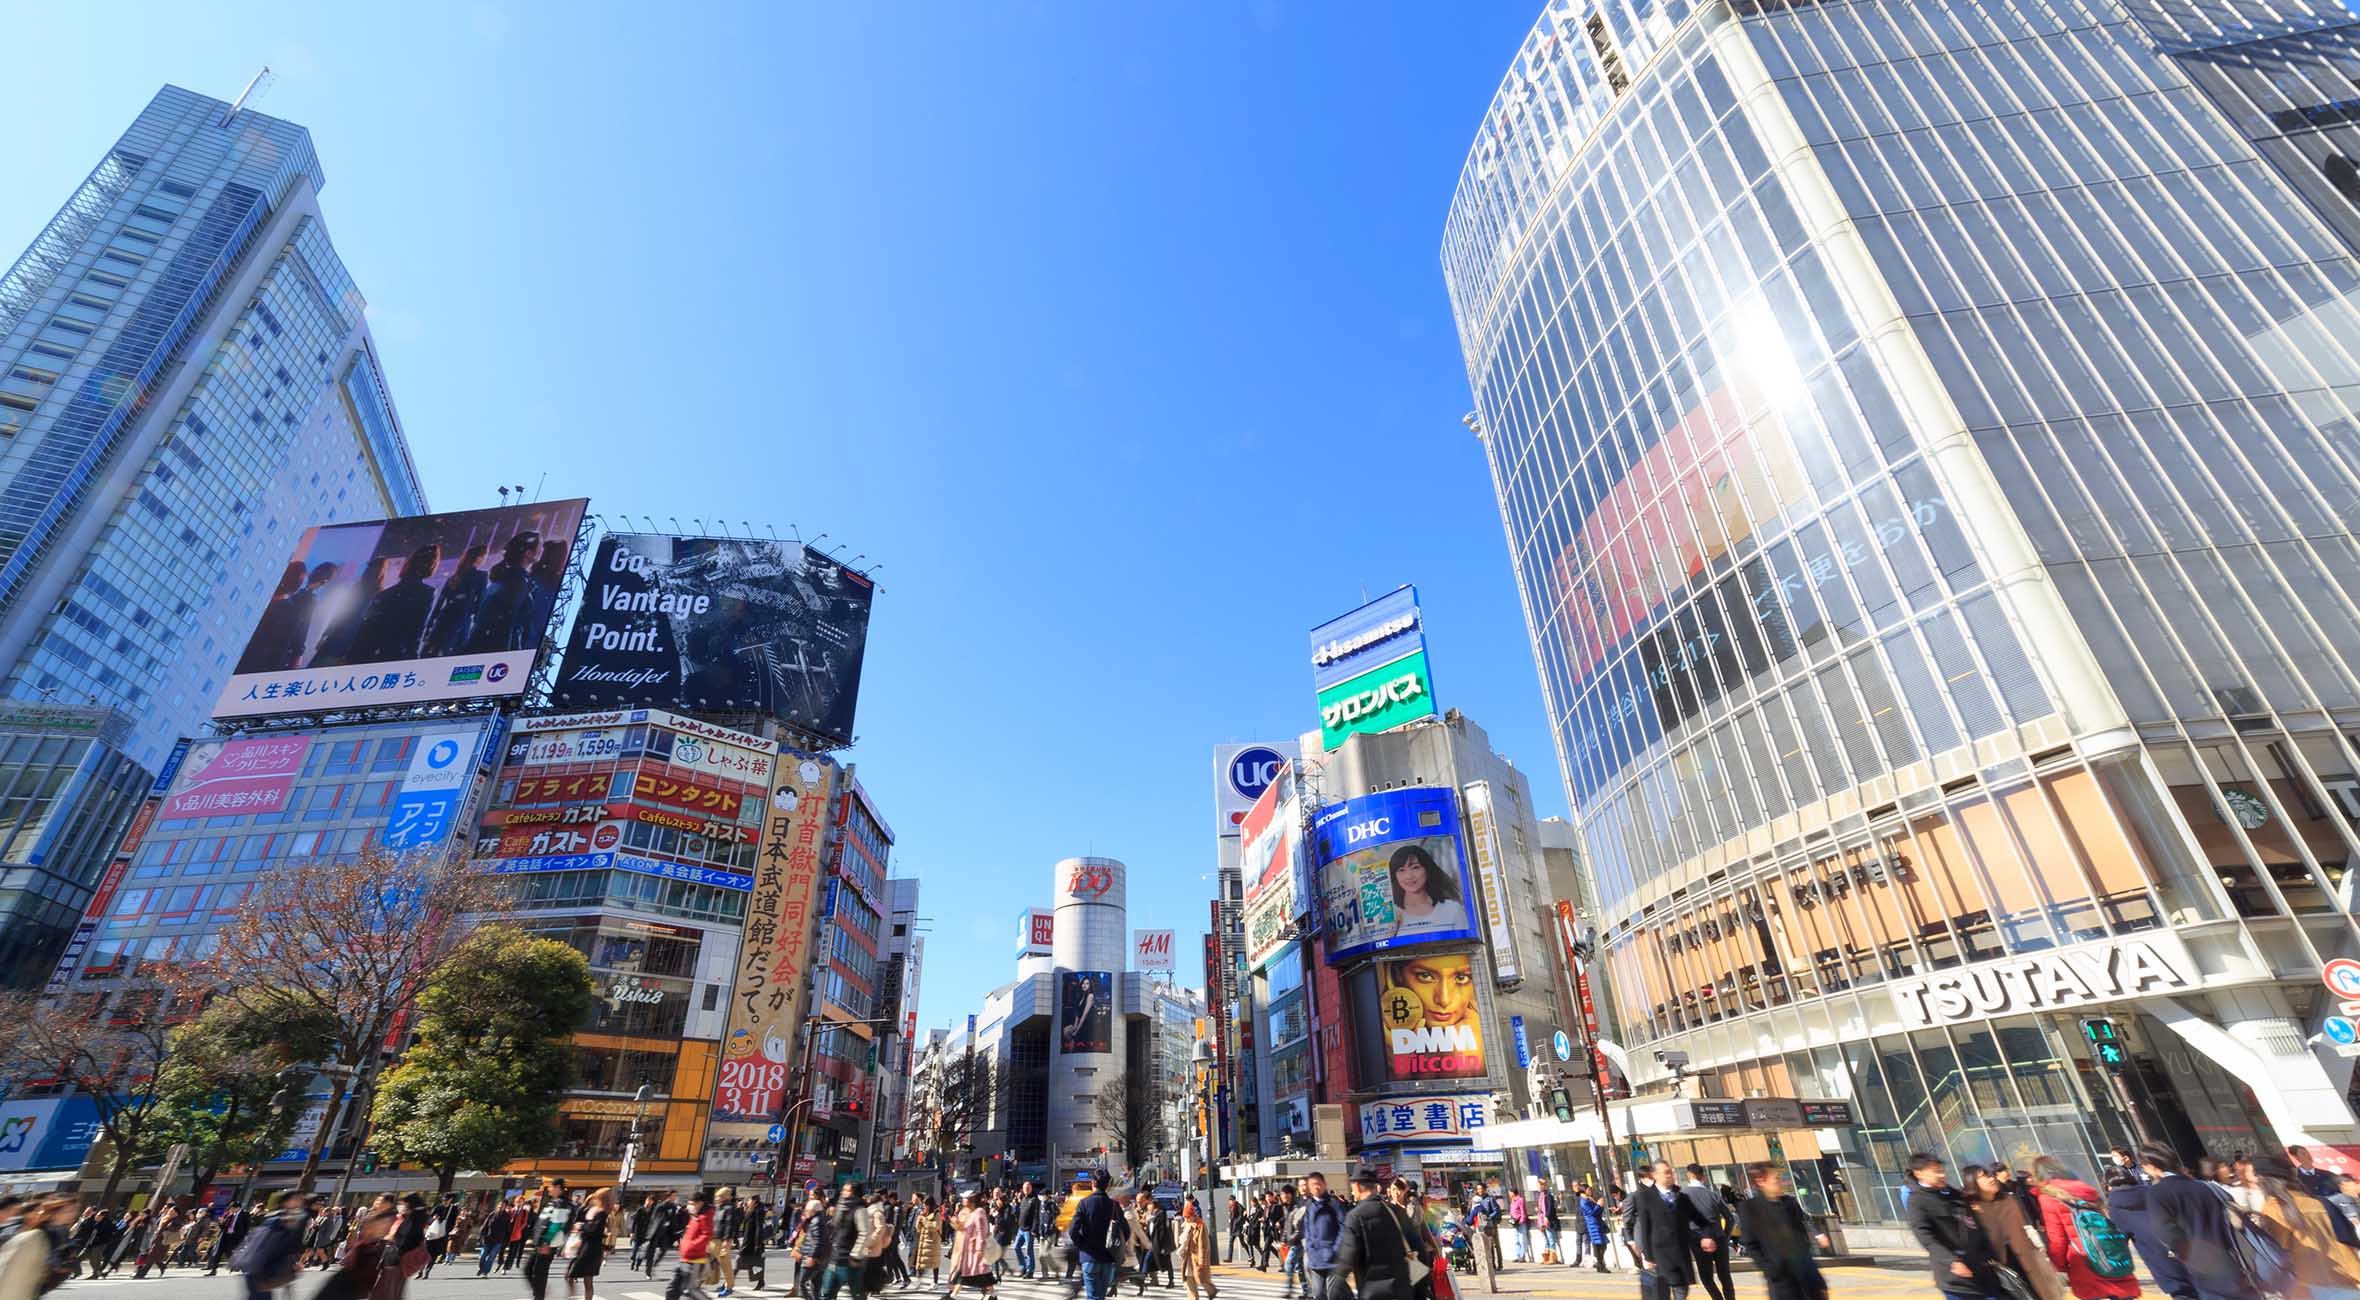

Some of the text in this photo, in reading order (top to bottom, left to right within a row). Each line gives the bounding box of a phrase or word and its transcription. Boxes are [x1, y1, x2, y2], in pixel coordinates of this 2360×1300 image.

[609, 547, 646, 572] Go
[601, 585, 709, 619] Vantage
[585, 624, 664, 652] Point.
[489, 667, 507, 678] UC
[569, 665, 671, 689] HondaJet
[242, 671, 426, 701] 人生楽しい人の勝ち。
[1322, 672, 1422, 728] サロンパス
[510, 744, 529, 756] 9F
[707, 748, 768, 775] しゃぶ葉
[635, 776, 737, 811] コンタクト
[562, 806, 608, 823] ガスト
[529, 832, 587, 854] ガスト
[701, 821, 748, 842] ガスト
[1347, 817, 1390, 844] DHC
[478, 838, 499, 852] 7F
[505, 856, 589, 870] 英会話イーオン
[662, 863, 752, 888] 英会話イーオン
[1482, 871, 1502, 926] neon
[741, 816, 791, 1024] 日本武道館だって。
[1035, 932, 1053, 945] QL
[1140, 934, 1170, 955] H&M
[1898, 942, 2188, 1025] TSUTAYA
[1391, 1025, 1478, 1055] DMM
[720, 1061, 785, 1091] 2018
[1393, 1053, 1480, 1073] Bitcoin
[723, 1087, 771, 1117] 3.11
[1363, 1103, 1486, 1137] 大盛堂書店
[840, 1135, 857, 1153] LUSH
